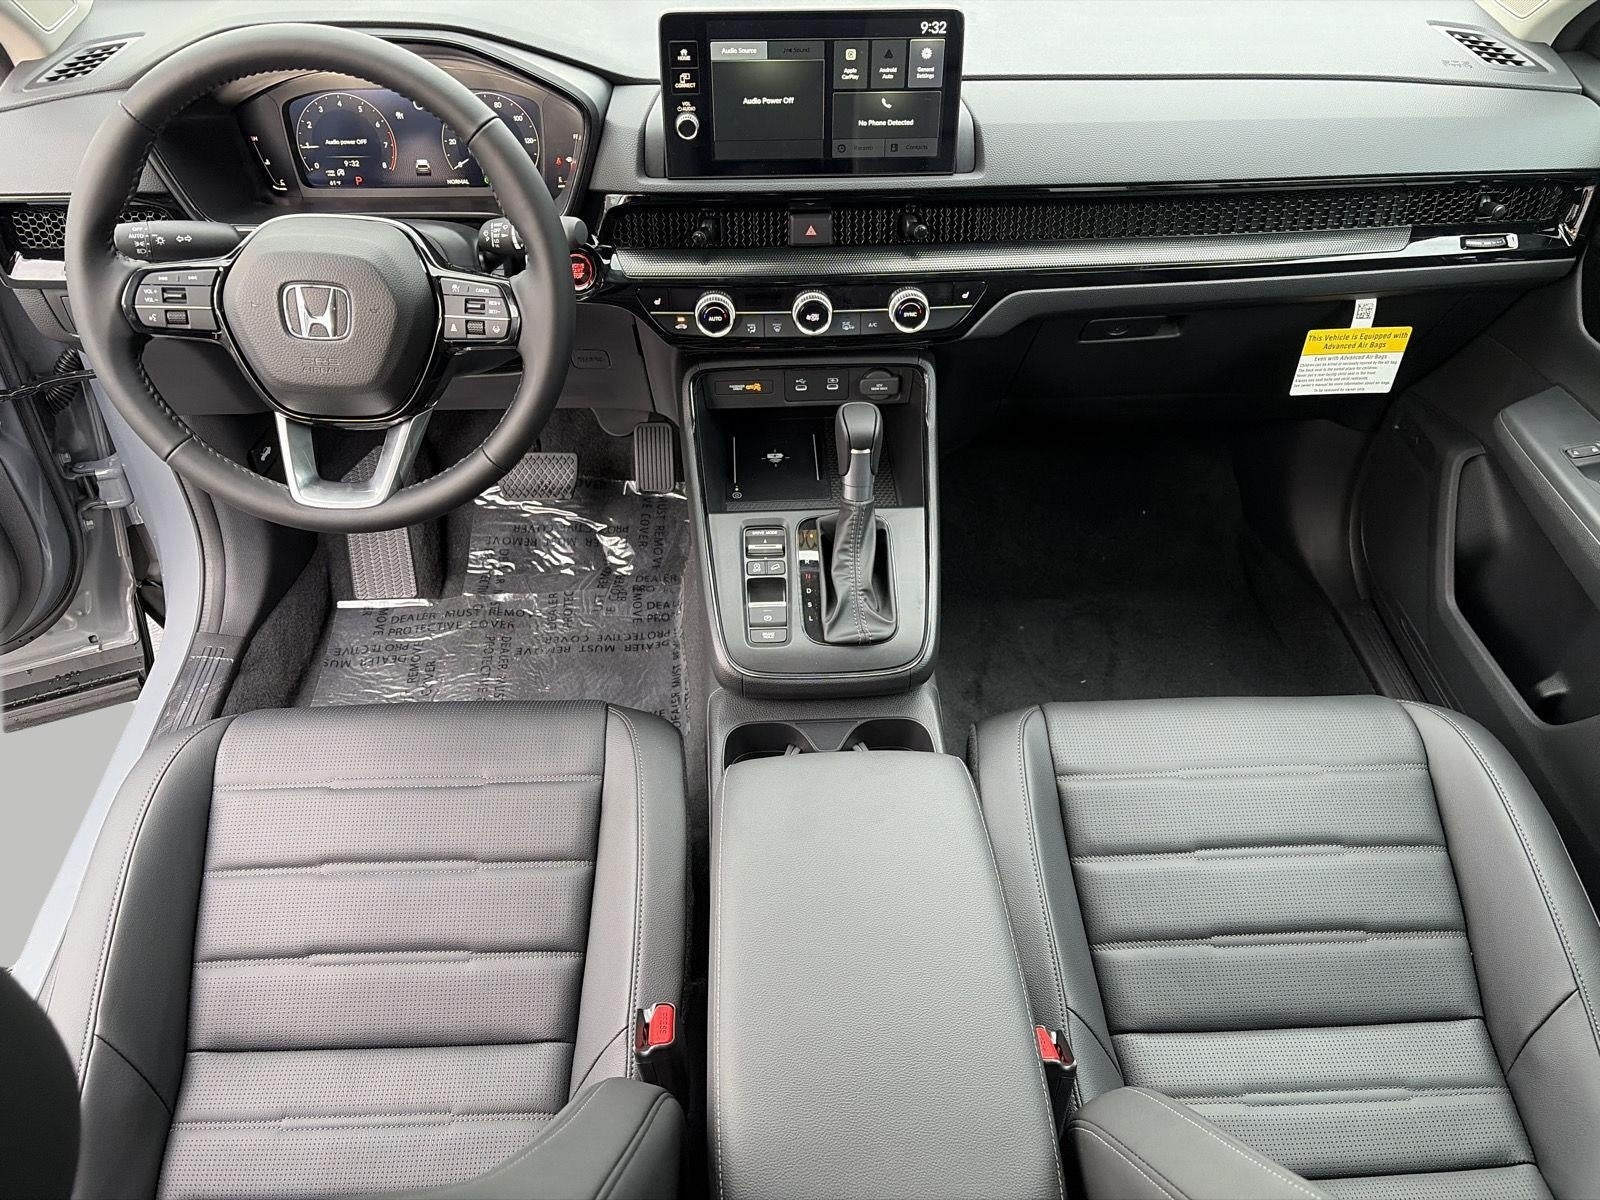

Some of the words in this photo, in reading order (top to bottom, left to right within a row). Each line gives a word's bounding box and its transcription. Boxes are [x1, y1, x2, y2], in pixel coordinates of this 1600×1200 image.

[920, 21, 947, 34] 9:32
[307, 121, 312, 129] 2
[355, 176, 362, 185] P
[1359, 332, 1391, 342] Equipped
[1393, 331, 1408, 339] with
[1323, 342, 1356, 350] Advanced
[1369, 341, 1387, 350] Bags
[391, 612, 437, 624] DEALER
[444, 608, 479, 618] MUST
[388, 621, 463, 636] PROTECTIVE
[470, 620, 515, 630] COVER
[597, 630, 671, 642] PROTECTIVE
[333, 643, 410, 656] PROTECTIVE
[578, 644, 615, 652] MUST
[624, 640, 670, 651] DEALER
[498, 635, 512, 671] DEALER
[407, 641, 424, 684] REMOVE
[421, 659, 437, 697] CVER
